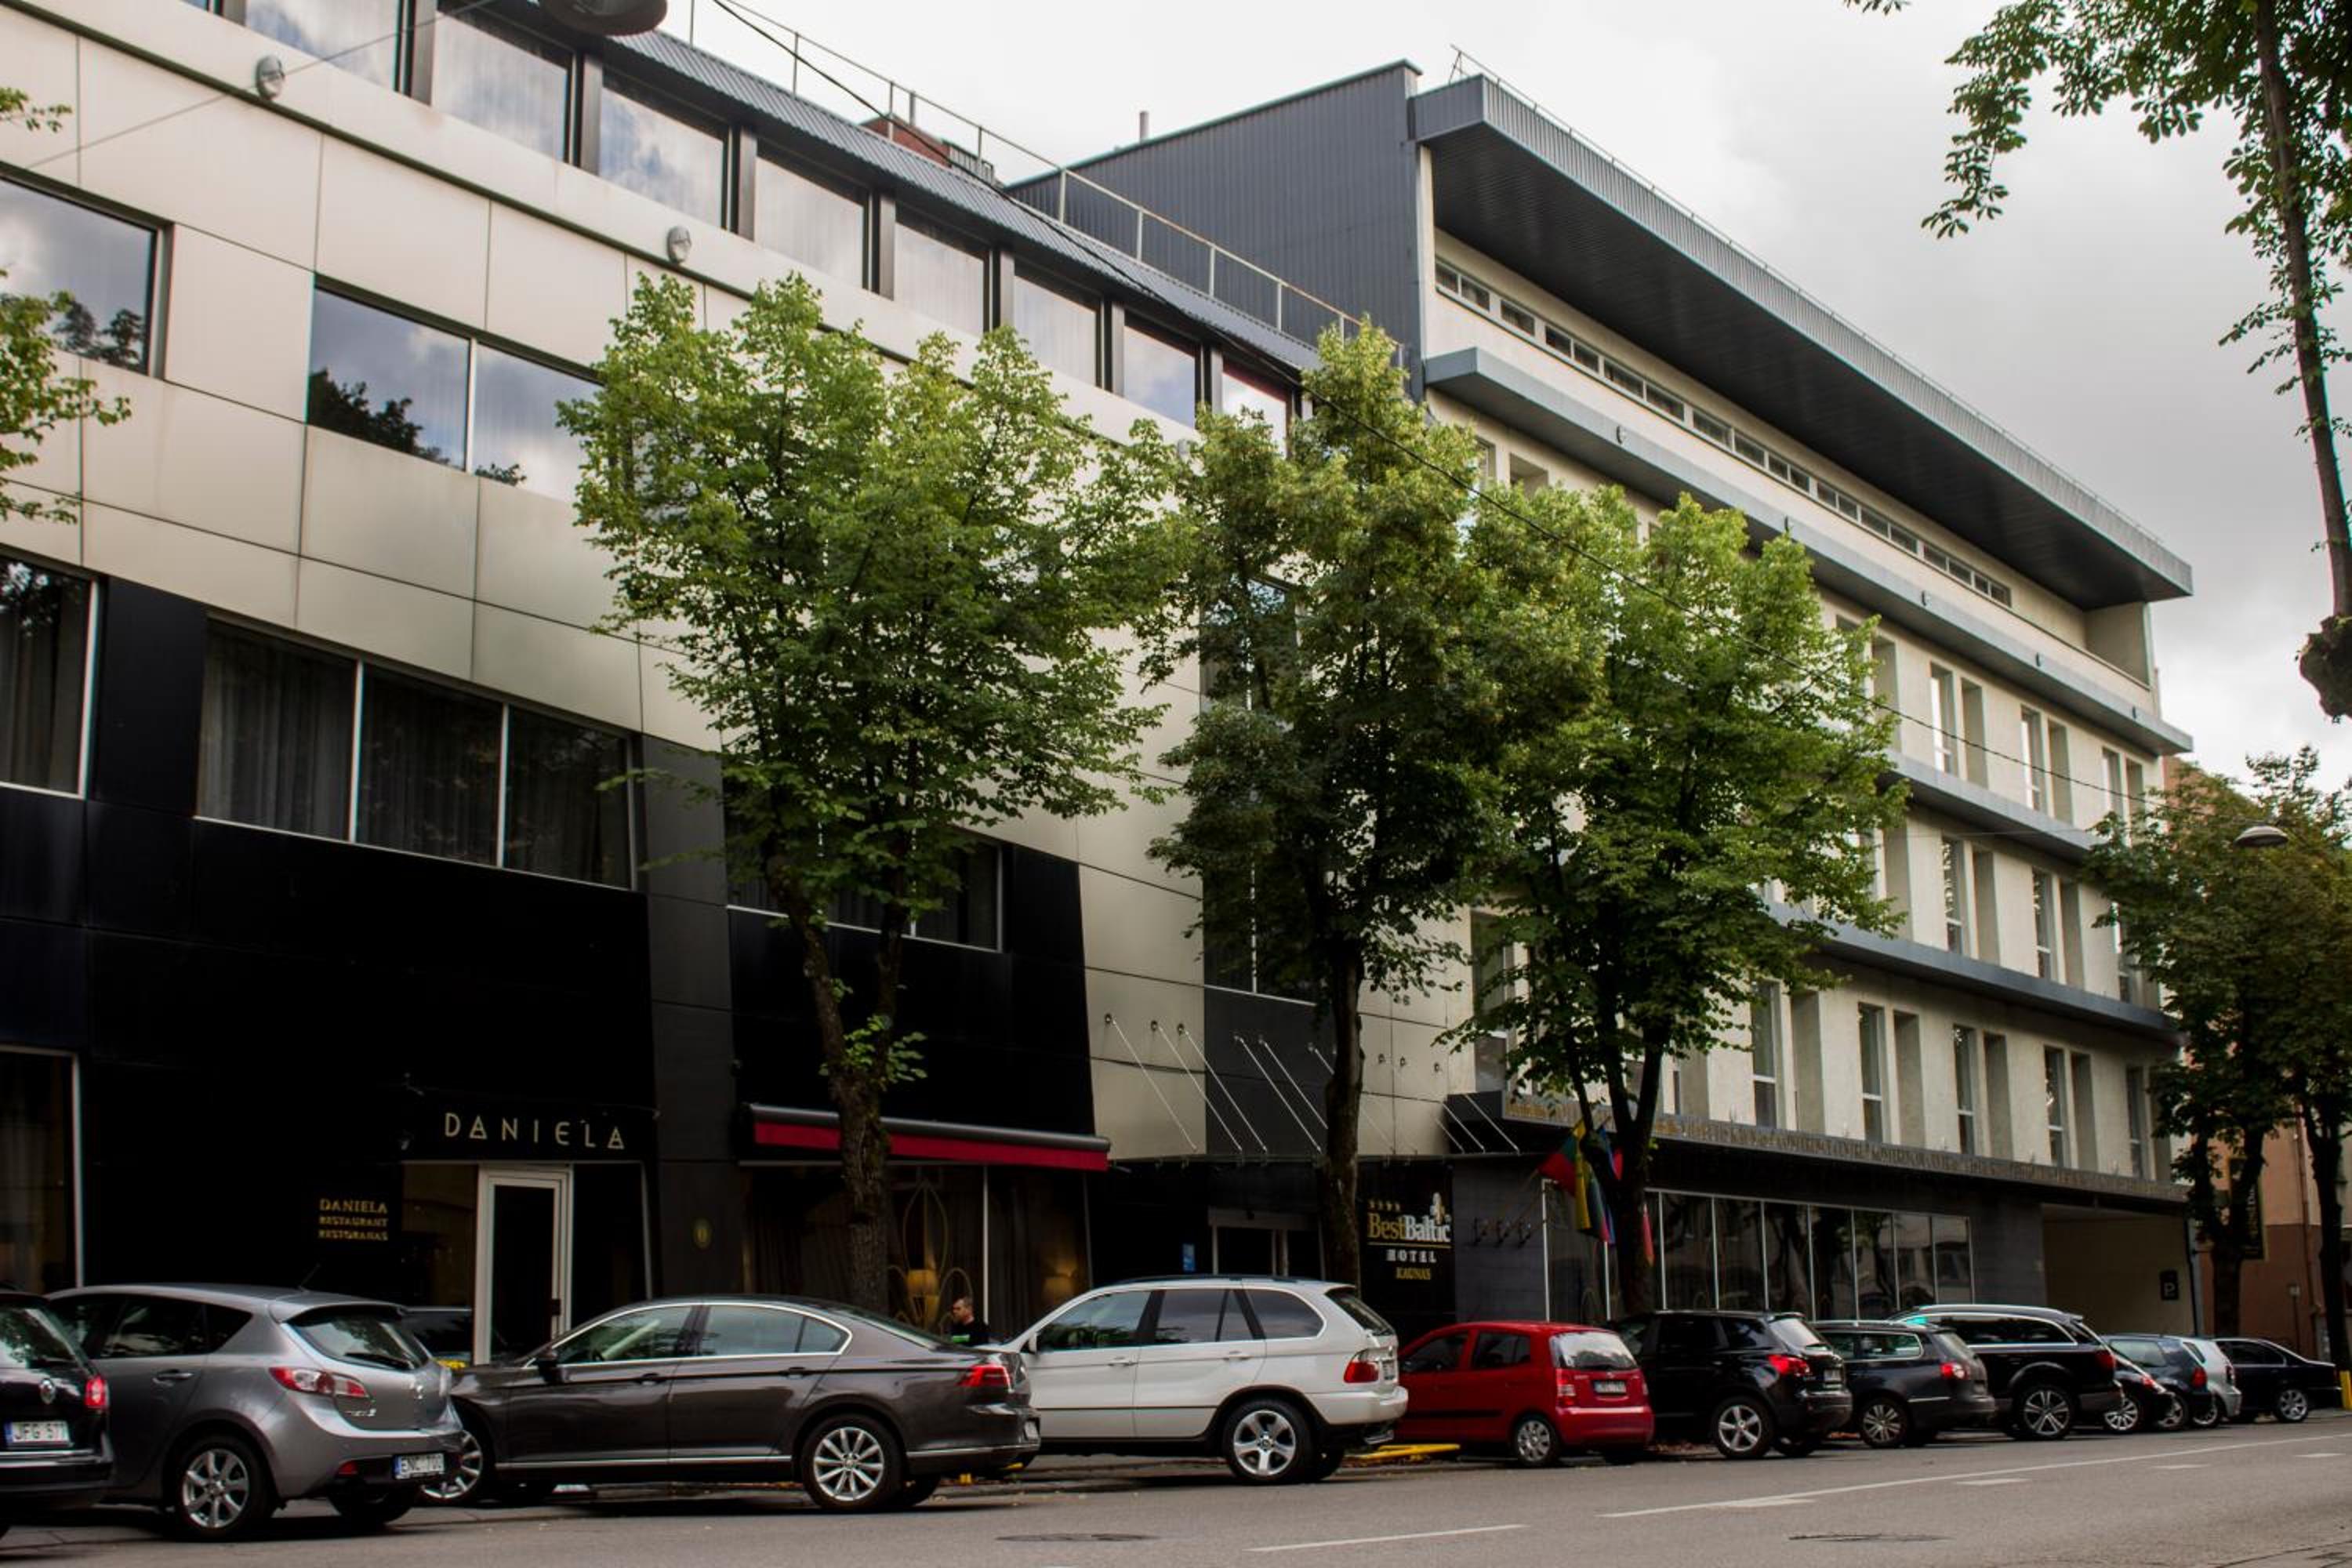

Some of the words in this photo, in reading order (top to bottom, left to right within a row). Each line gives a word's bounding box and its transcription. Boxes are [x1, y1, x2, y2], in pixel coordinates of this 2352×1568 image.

[445, 1112, 625, 1150] DANIELA
[318, 1198, 388, 1214] DANIELA
[318, 1215, 389, 1228] RESTAURANT
[1367, 1212, 1451, 1243] BestBaltic
[318, 1229, 389, 1241] RESTORANAS
[1385, 1248, 1436, 1263] HOTEL
[2164, 1282, 2176, 1296] P
